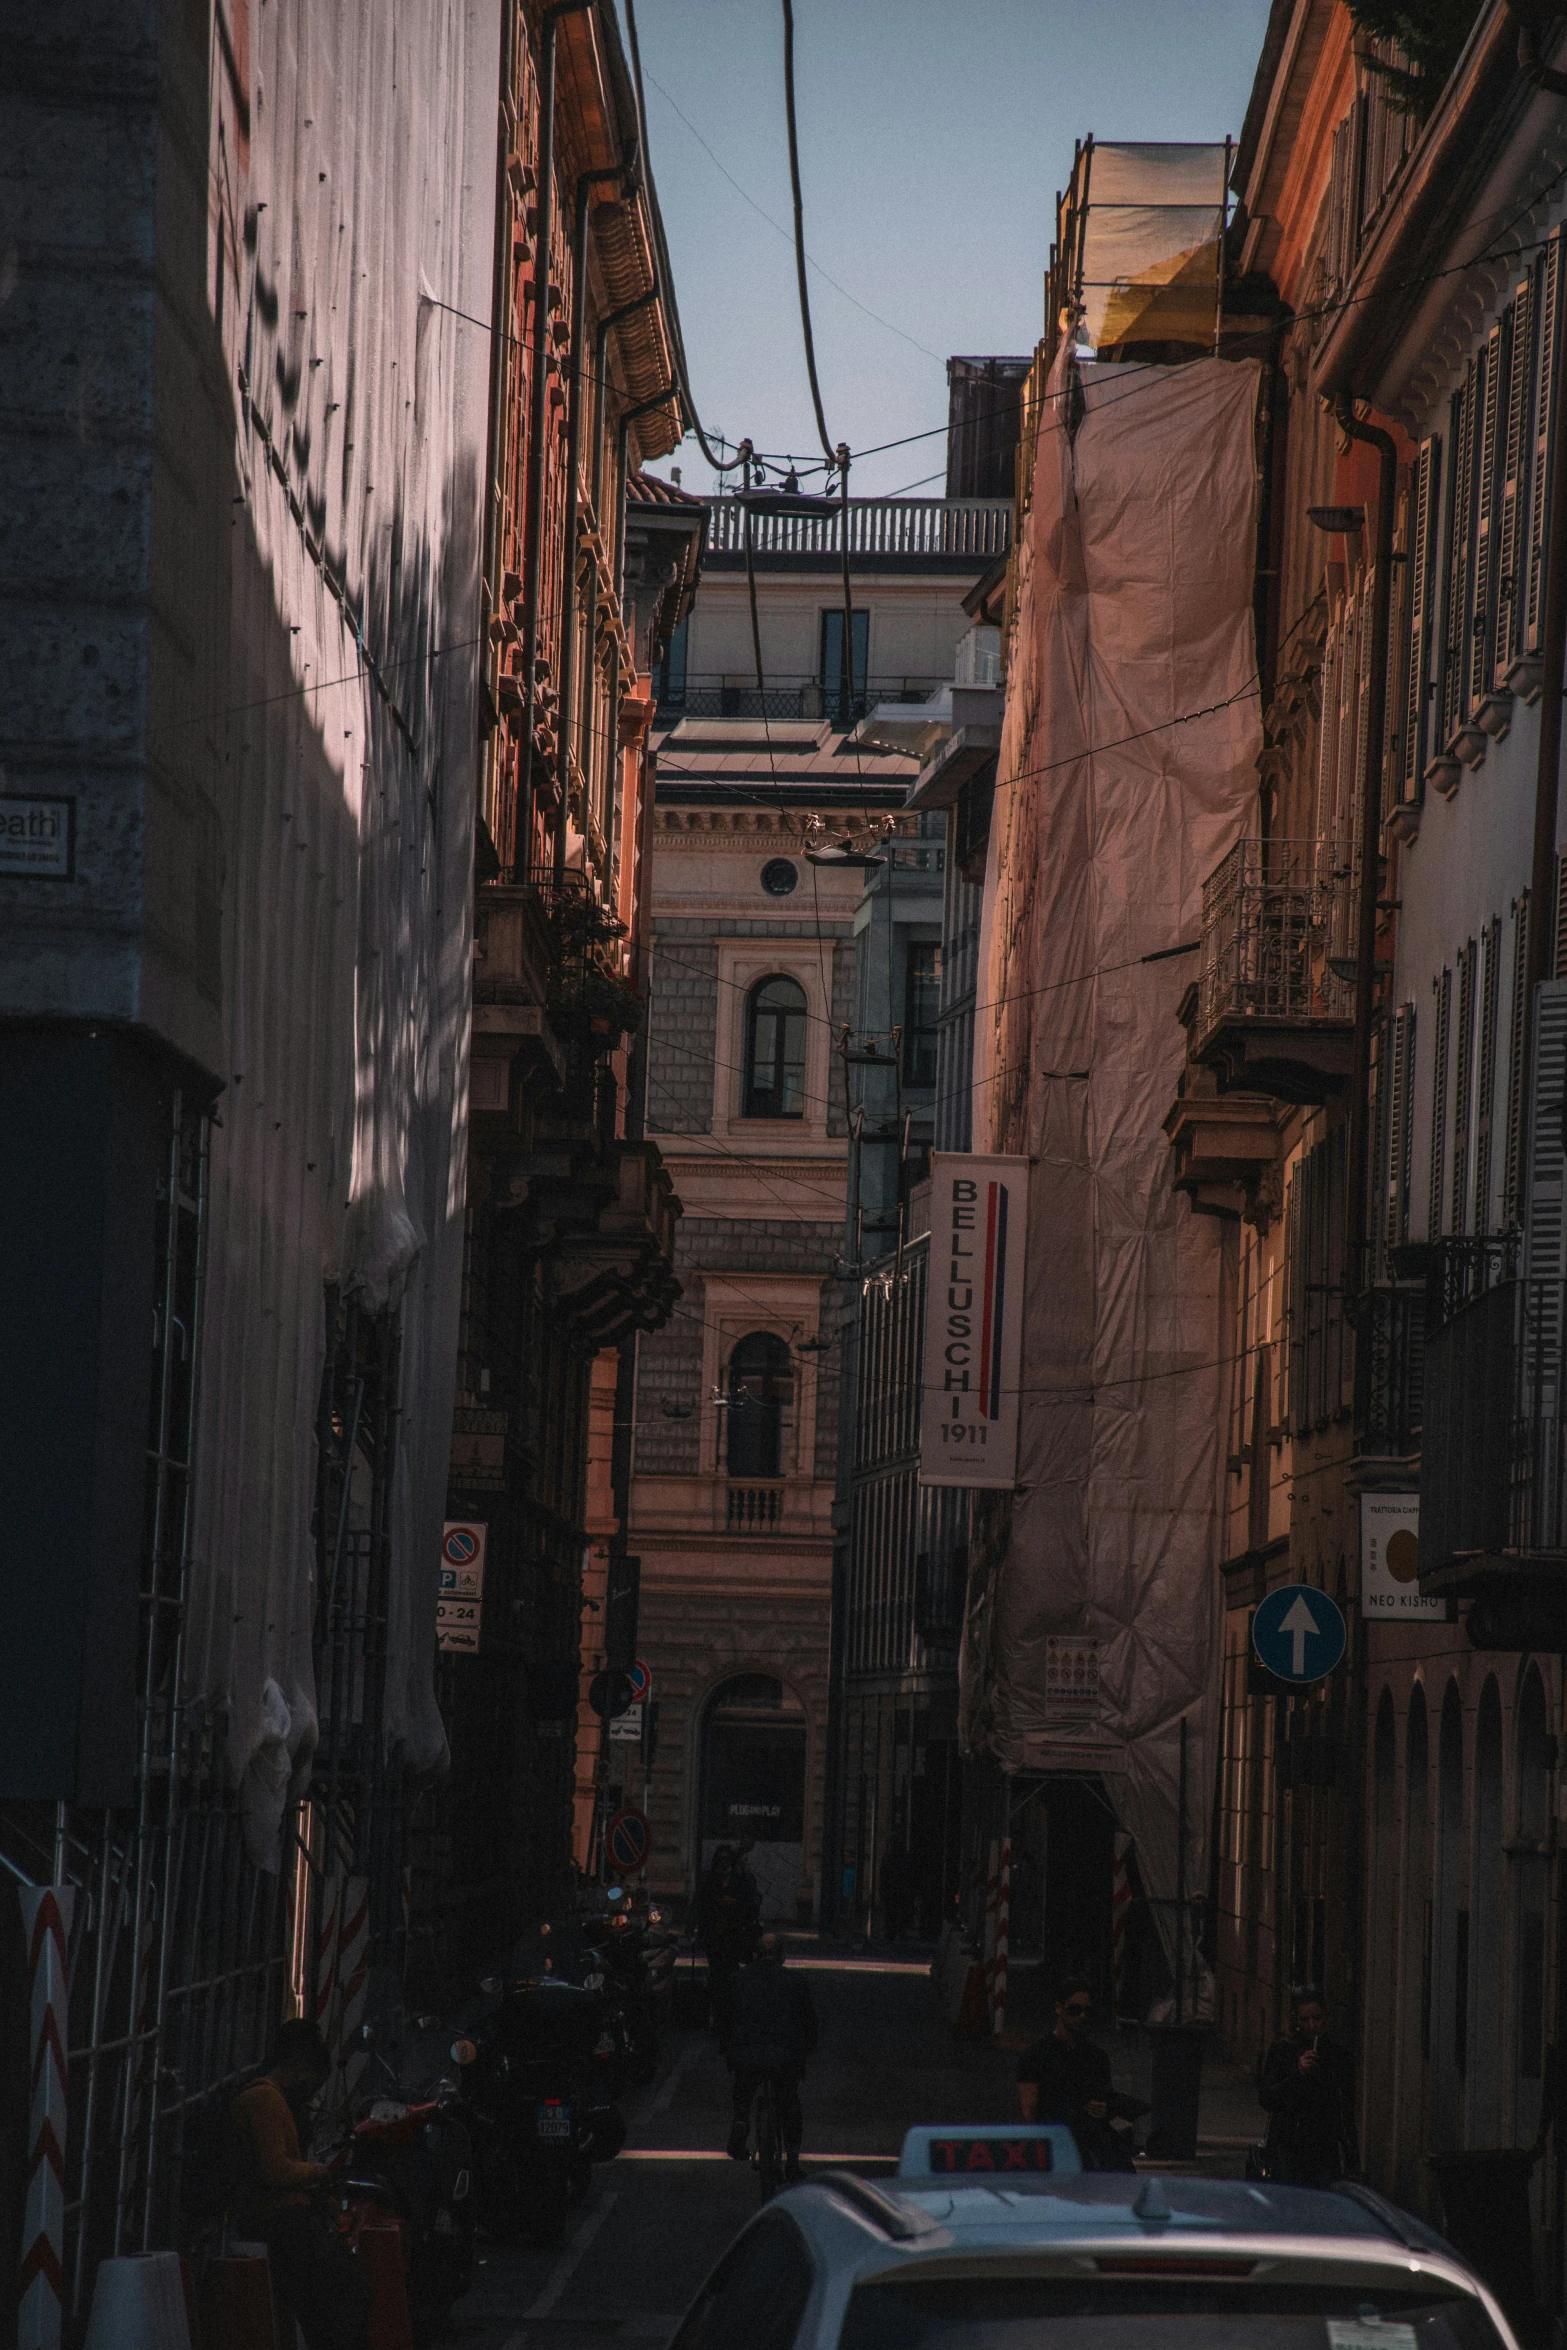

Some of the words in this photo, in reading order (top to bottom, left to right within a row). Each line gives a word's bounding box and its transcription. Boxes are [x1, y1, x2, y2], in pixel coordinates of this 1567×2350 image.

[945, 1180, 977, 1419] BELLUSCHI
[941, 1423, 987, 1444] 1911
[1370, 1506, 1402, 1514] TRATTORIA
[442, 1572, 453, 1586] P
[1370, 1594, 1395, 1607] NEO
[1400, 1595, 1438, 1608] KISHO
[457, 1607, 475, 1619] 24
[541, 2121, 569, 2134] 12079
[935, 2139, 1047, 2171] TAXI
